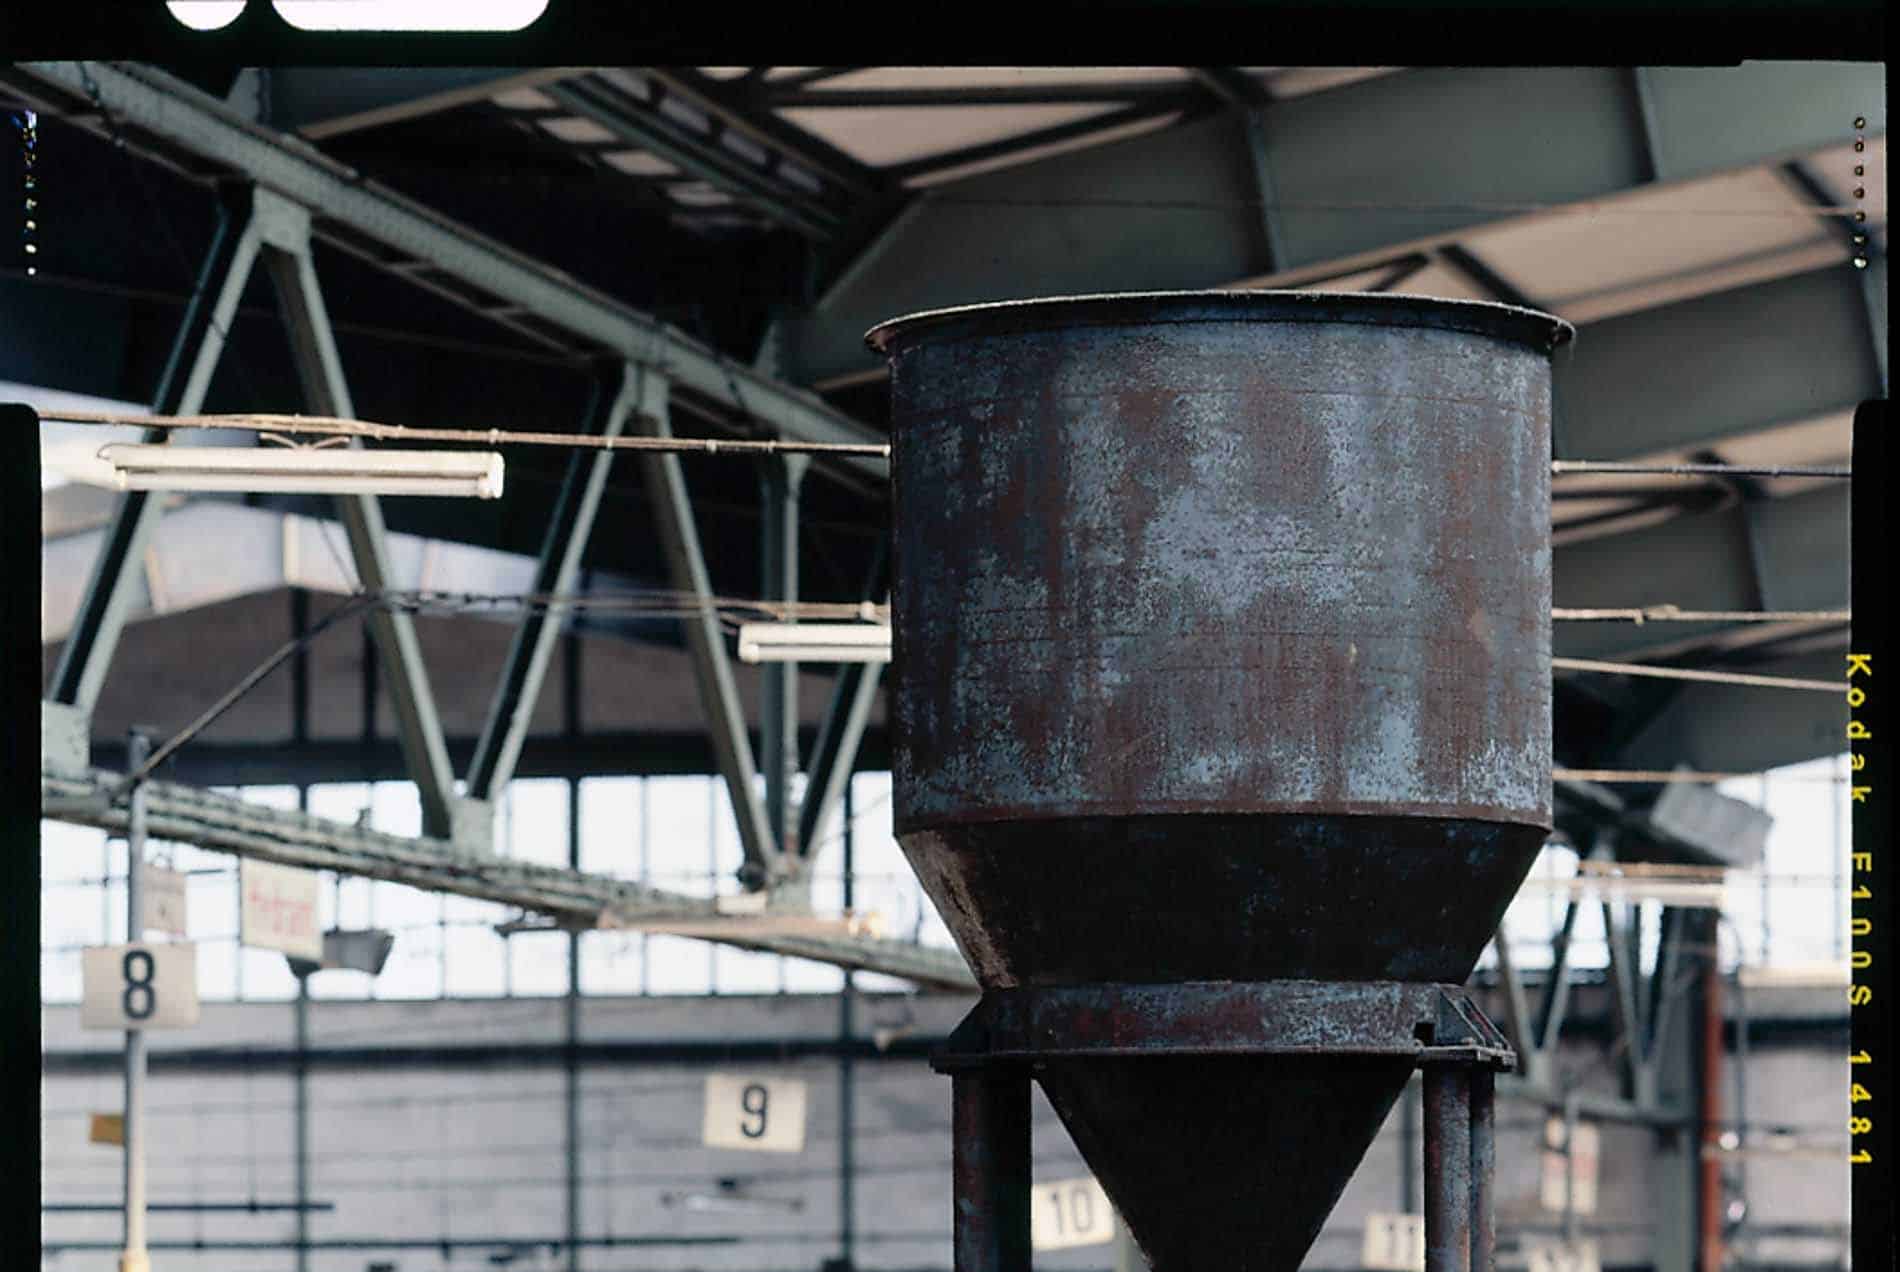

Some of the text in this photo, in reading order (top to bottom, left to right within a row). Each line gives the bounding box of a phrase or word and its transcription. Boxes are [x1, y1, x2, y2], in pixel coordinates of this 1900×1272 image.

[1846, 653, 1873, 802] Kodak
[122, 949, 155, 1020] 8
[740, 1083, 769, 1139] 9
[1848, 1049, 1873, 1164] 1481
[1050, 1187, 1094, 1236] 10
